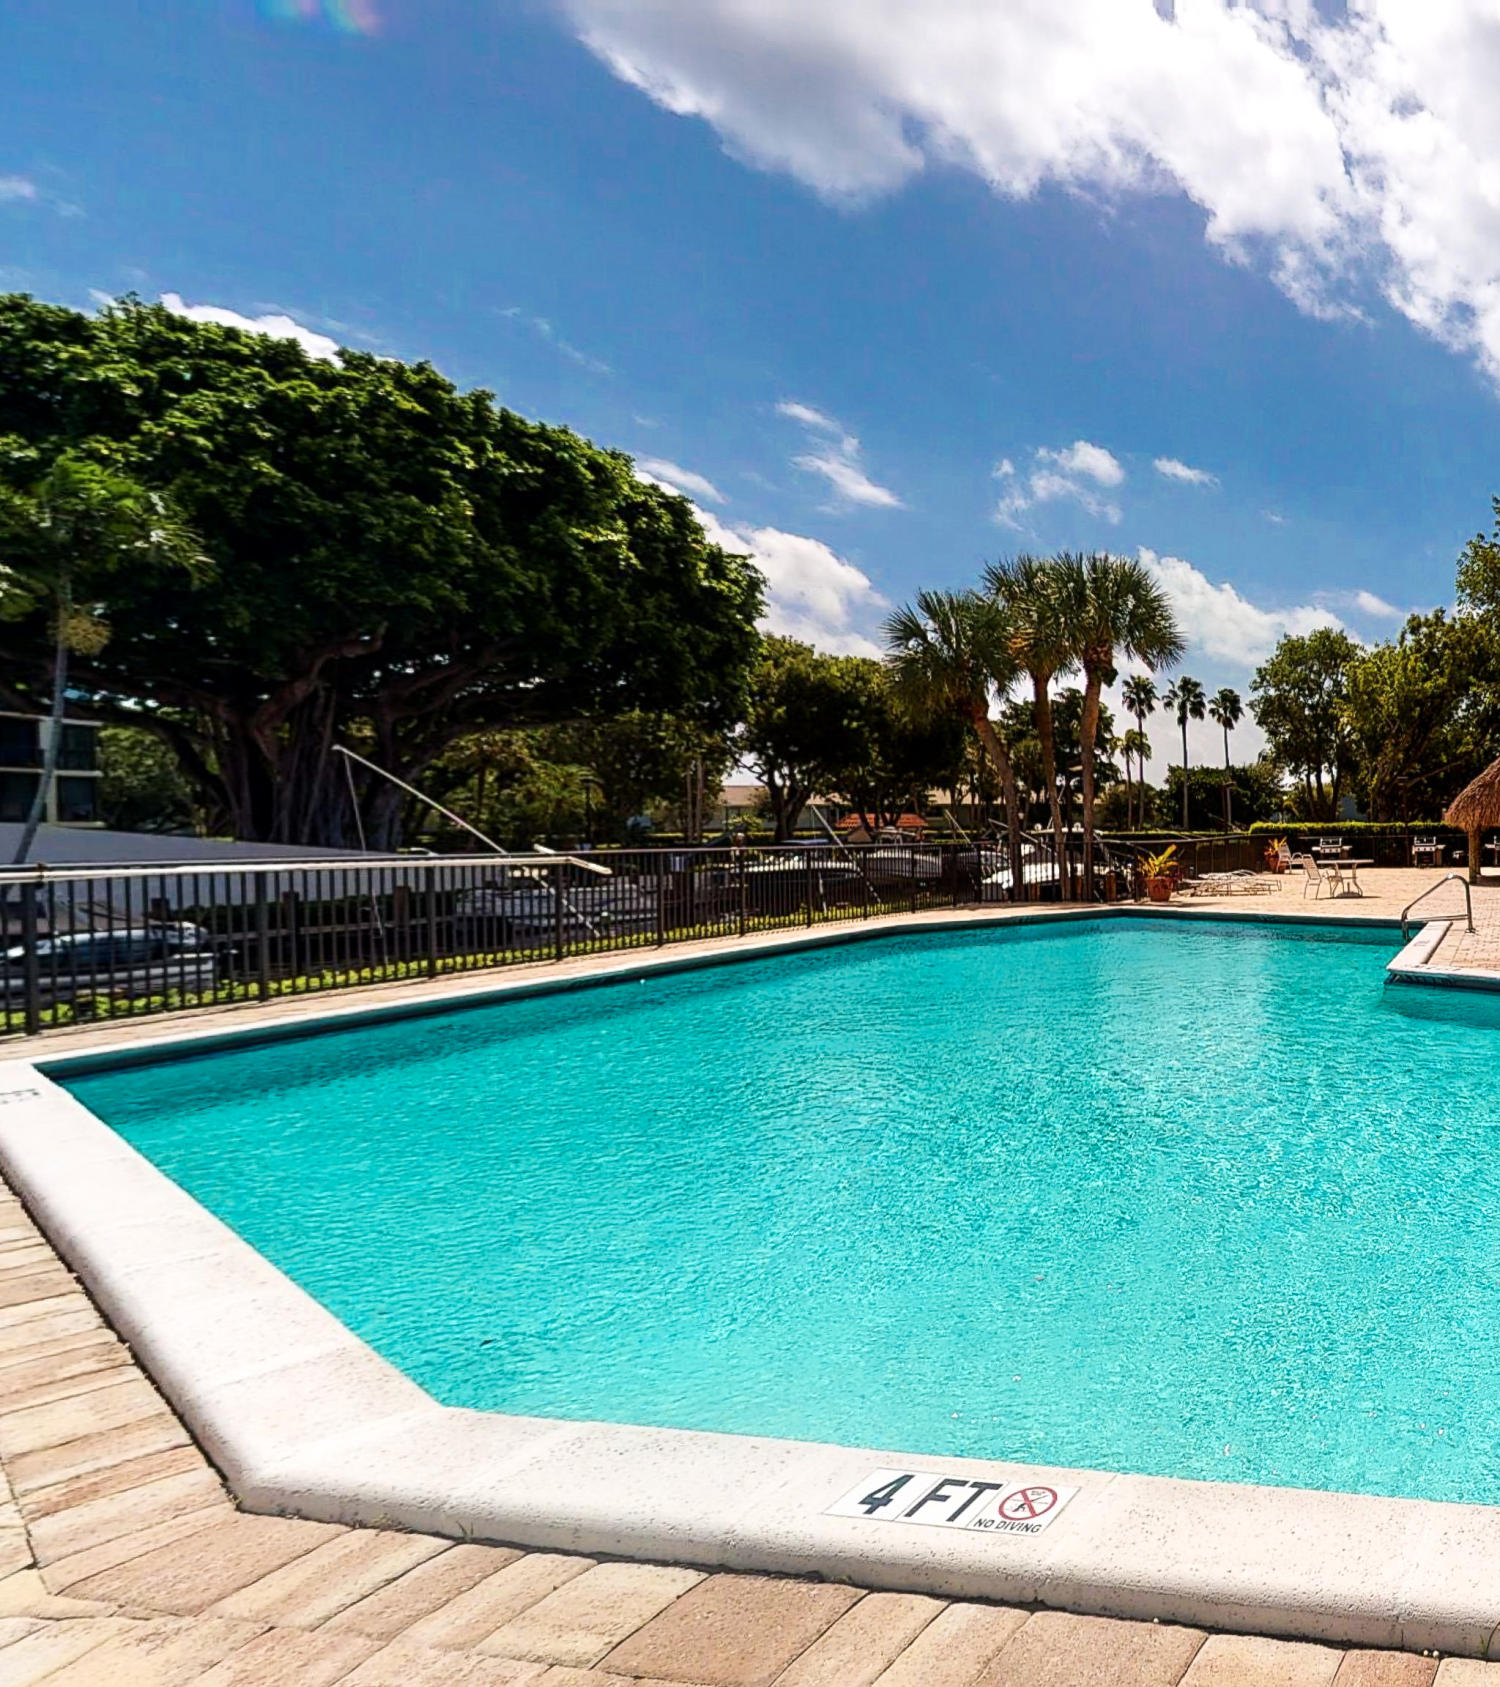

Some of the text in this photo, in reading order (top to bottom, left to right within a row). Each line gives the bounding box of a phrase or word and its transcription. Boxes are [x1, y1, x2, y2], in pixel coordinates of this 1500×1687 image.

[858, 1474, 1003, 1522] 4 FT
[974, 1518, 1043, 1533] NO DIVING
